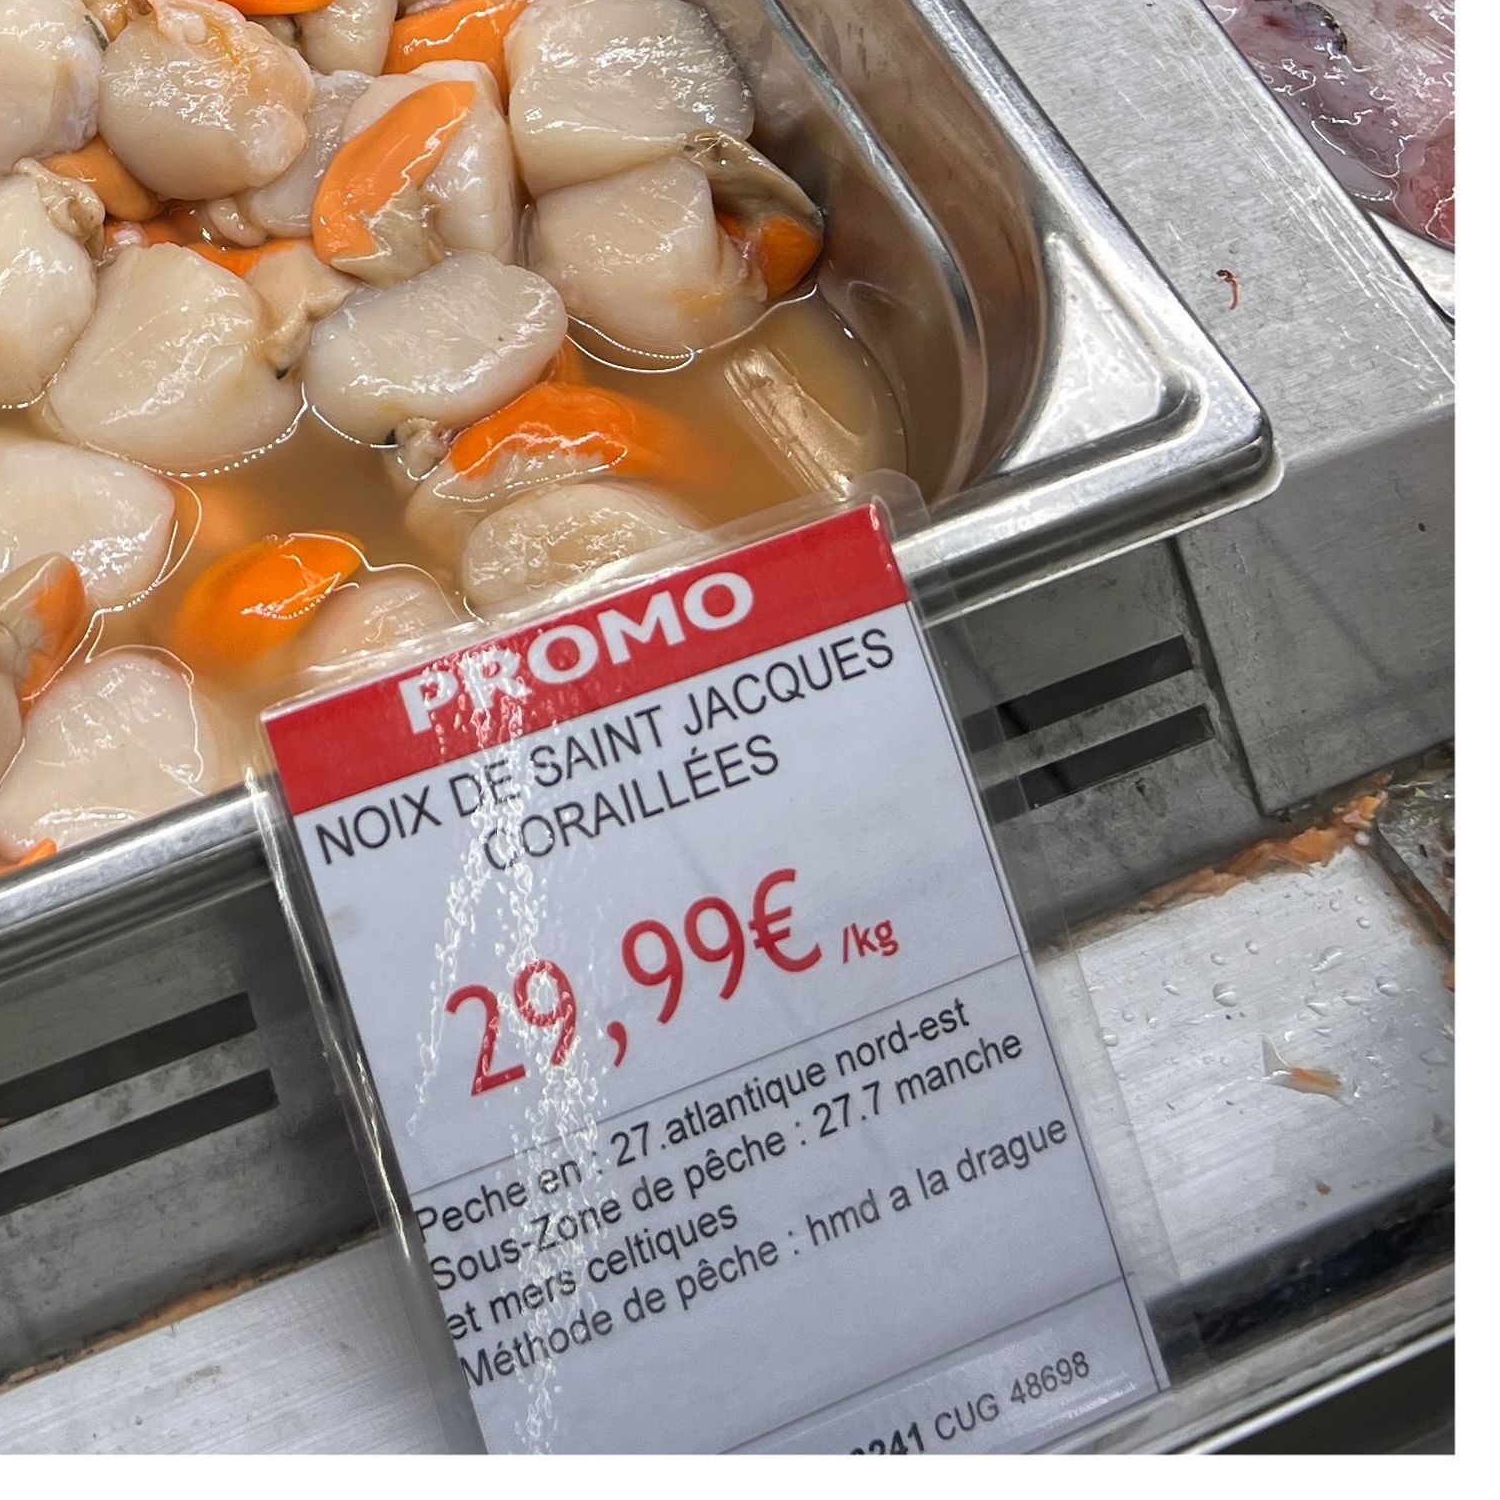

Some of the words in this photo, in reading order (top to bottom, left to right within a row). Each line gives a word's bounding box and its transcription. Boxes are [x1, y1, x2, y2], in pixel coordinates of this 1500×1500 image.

[314, 785, 443, 865] NOIX
[448, 758, 521, 817] DE
[529, 704, 662, 788] SAINT
[683, 628, 894, 736] JACQUES
[399, 572, 754, 734] PROMO
[483, 734, 779, 871] CORAILLÉES
[445, 868, 822, 1097] 29,99€
[842, 919, 899, 964] /kg
[414, 1183, 528, 1243] Peche
[537, 1158, 583, 1195] en
[610, 1061, 827, 1168] 27.atlantique
[834, 997, 970, 1077] nord-est
[430, 1196, 623, 1290] Sous-Zone
[631, 1175, 676, 1212] de
[683, 1130, 787, 1200] pêche
[811, 1080, 881, 1138] 27.7
[894, 1034, 1023, 1105] manche
[447, 1301, 483, 1341] et
[489, 1268, 578, 1325] mers
[587, 1203, 739, 1284] celtiques
[459, 1308, 614, 1389] Méthode
[623, 1286, 667, 1323] de
[675, 1238, 780, 1311] pêche
[805, 1188, 882, 1247] hmd
[888, 1185, 912, 1212] a
[916, 1168, 950, 1200] la
[956, 1119, 1068, 1183] drague
[934, 1393, 1001, 1441] CUG
[1010, 1351, 1090, 1405] 48698
